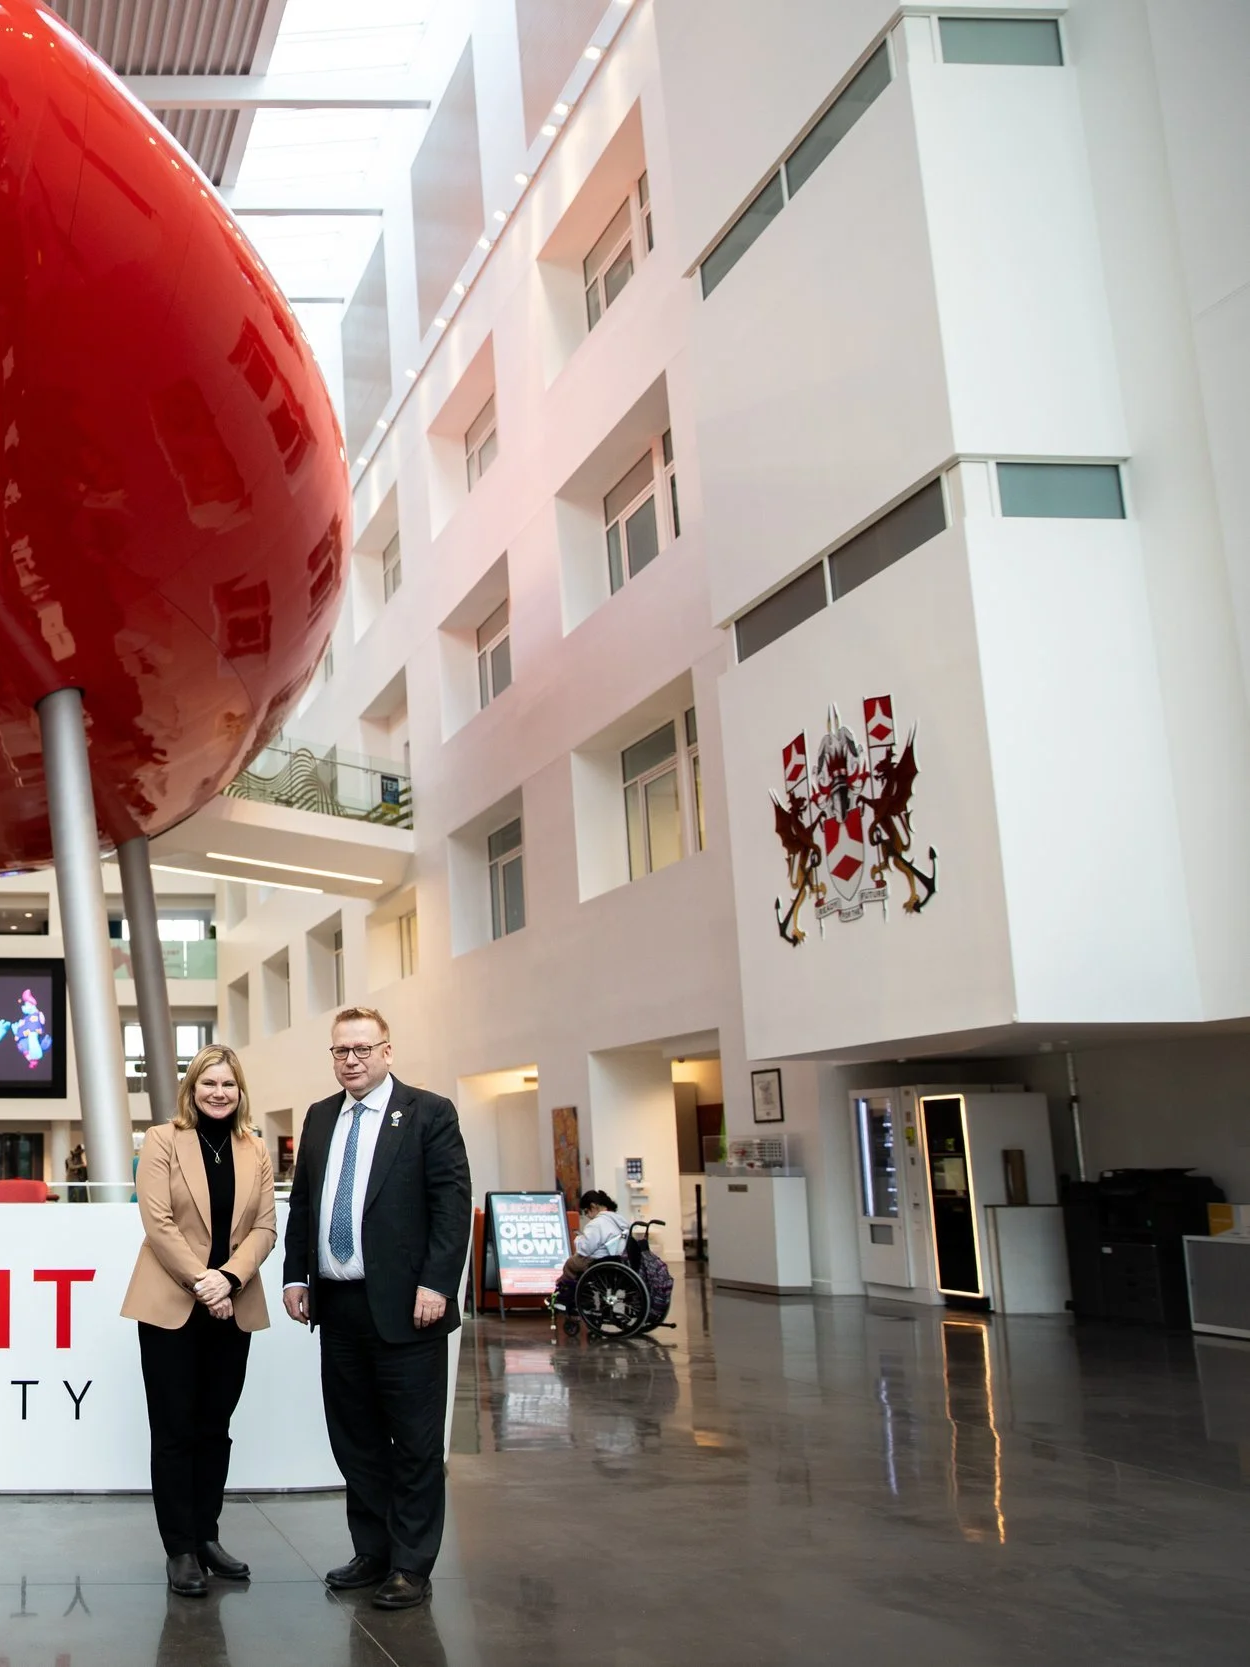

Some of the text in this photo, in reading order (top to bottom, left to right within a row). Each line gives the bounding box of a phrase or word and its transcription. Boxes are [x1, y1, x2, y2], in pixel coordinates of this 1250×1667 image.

[499, 1214, 560, 1222] APPLICATIONS
[499, 1222, 562, 1239] OPEN
[500, 1238, 564, 1255] NOW!
